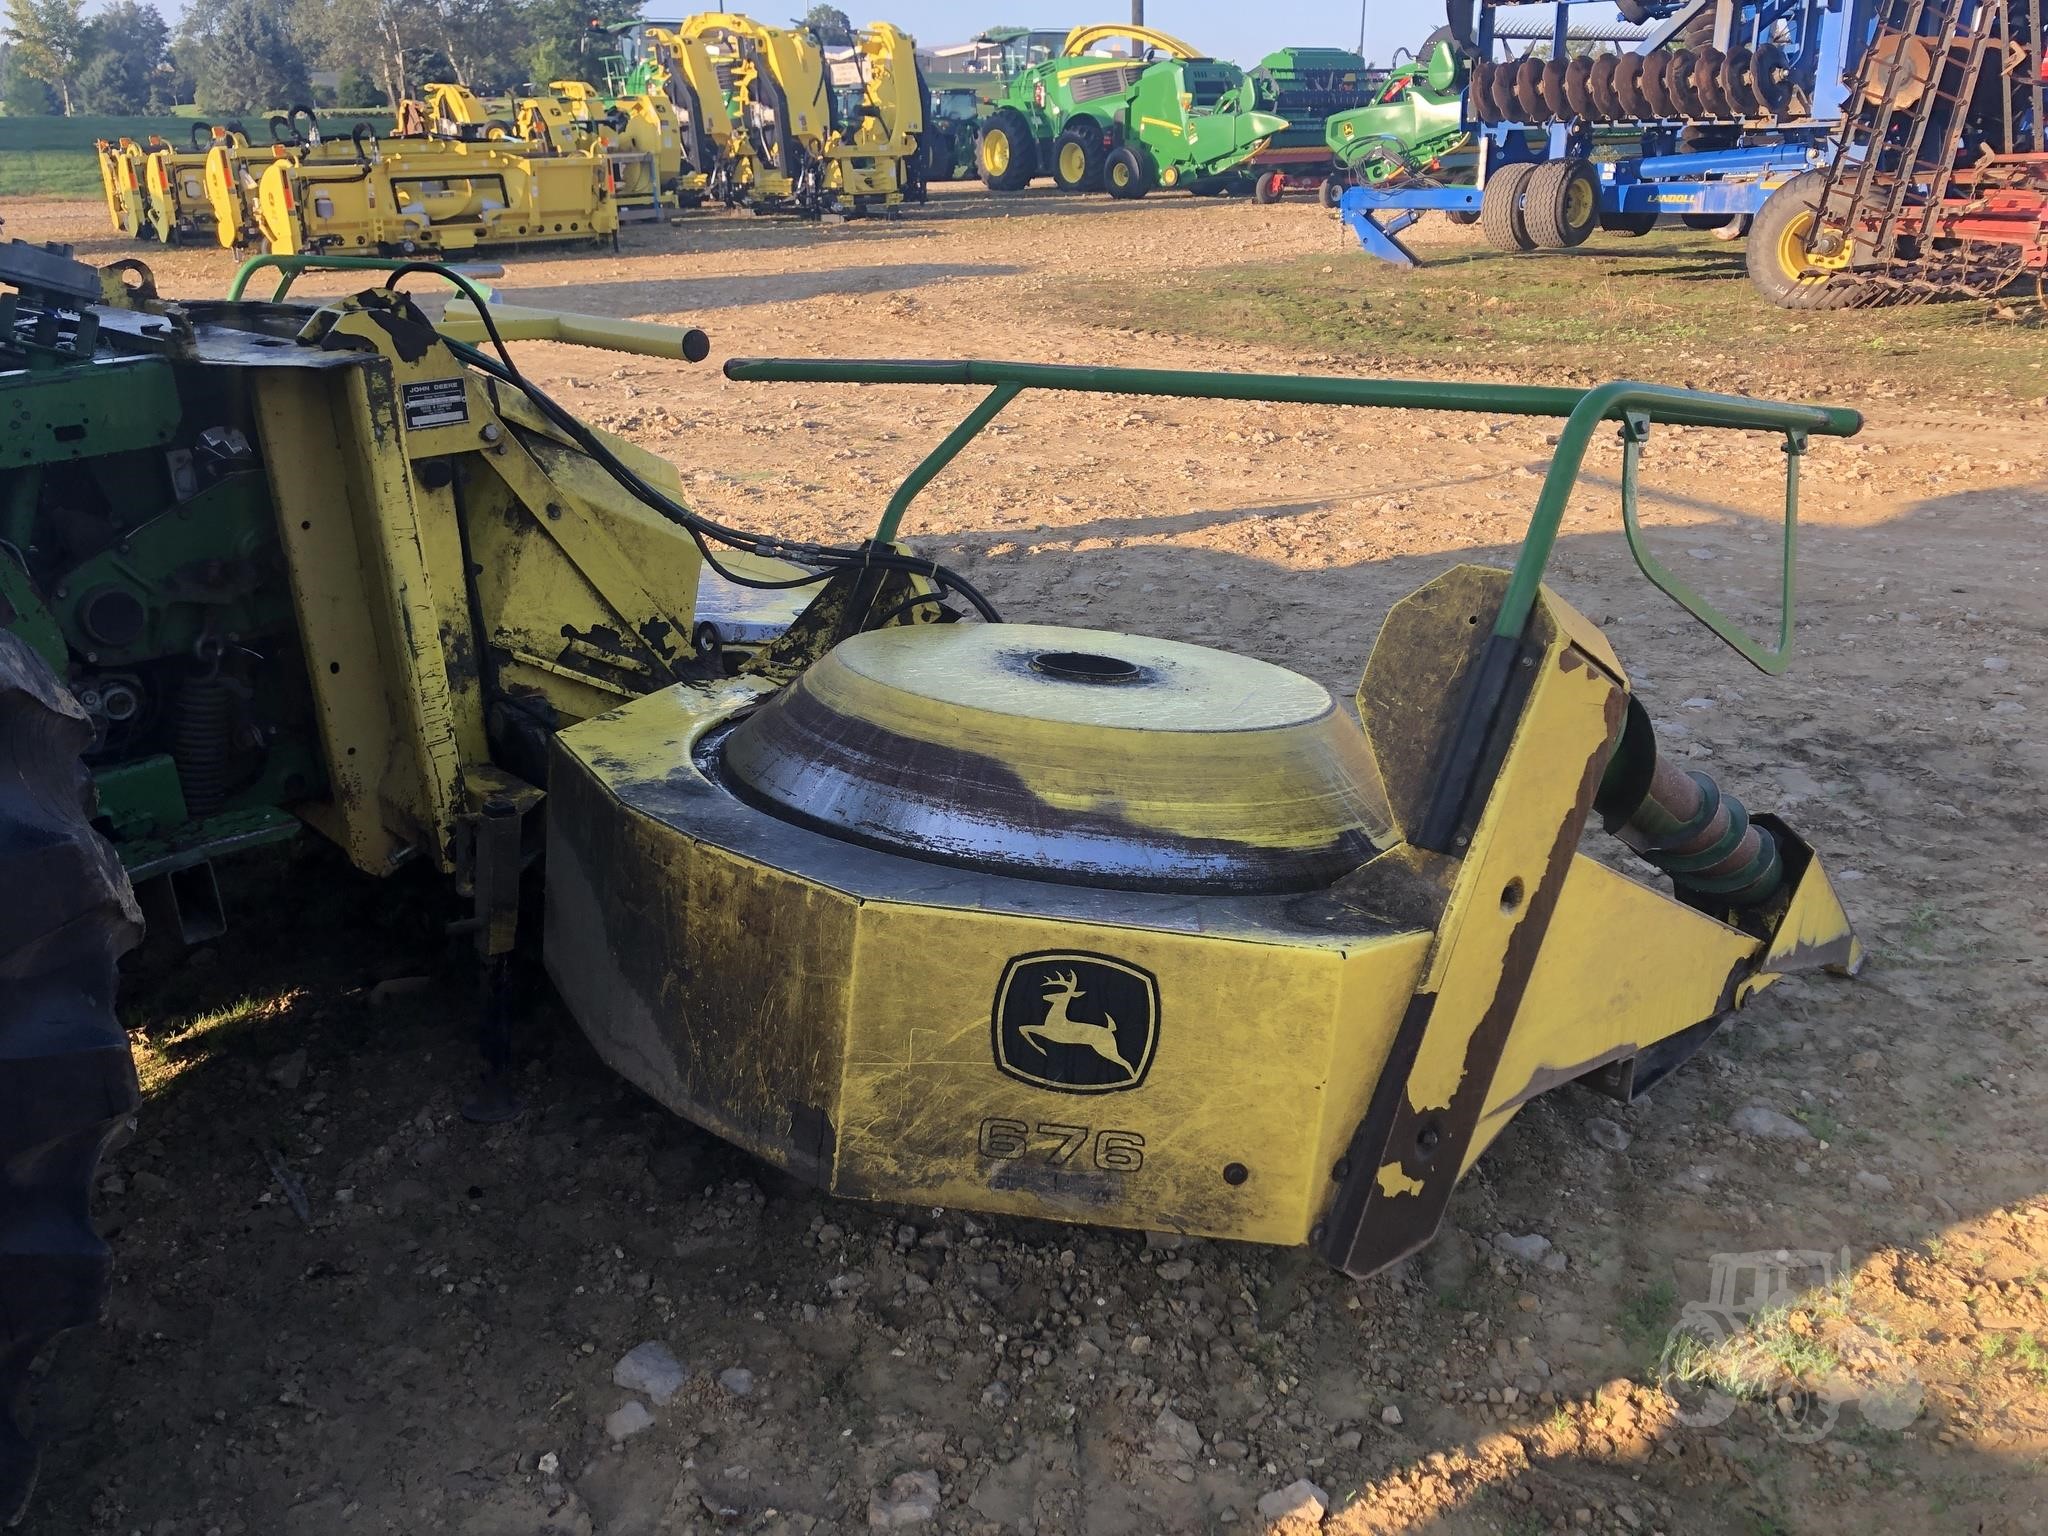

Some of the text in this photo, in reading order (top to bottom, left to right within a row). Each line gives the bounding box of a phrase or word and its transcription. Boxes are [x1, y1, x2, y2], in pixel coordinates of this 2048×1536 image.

[1647, 194, 1696, 203] LANDOLL
[409, 382, 458, 393] JOHN DEERE
[977, 1117, 1146, 1172] 676
